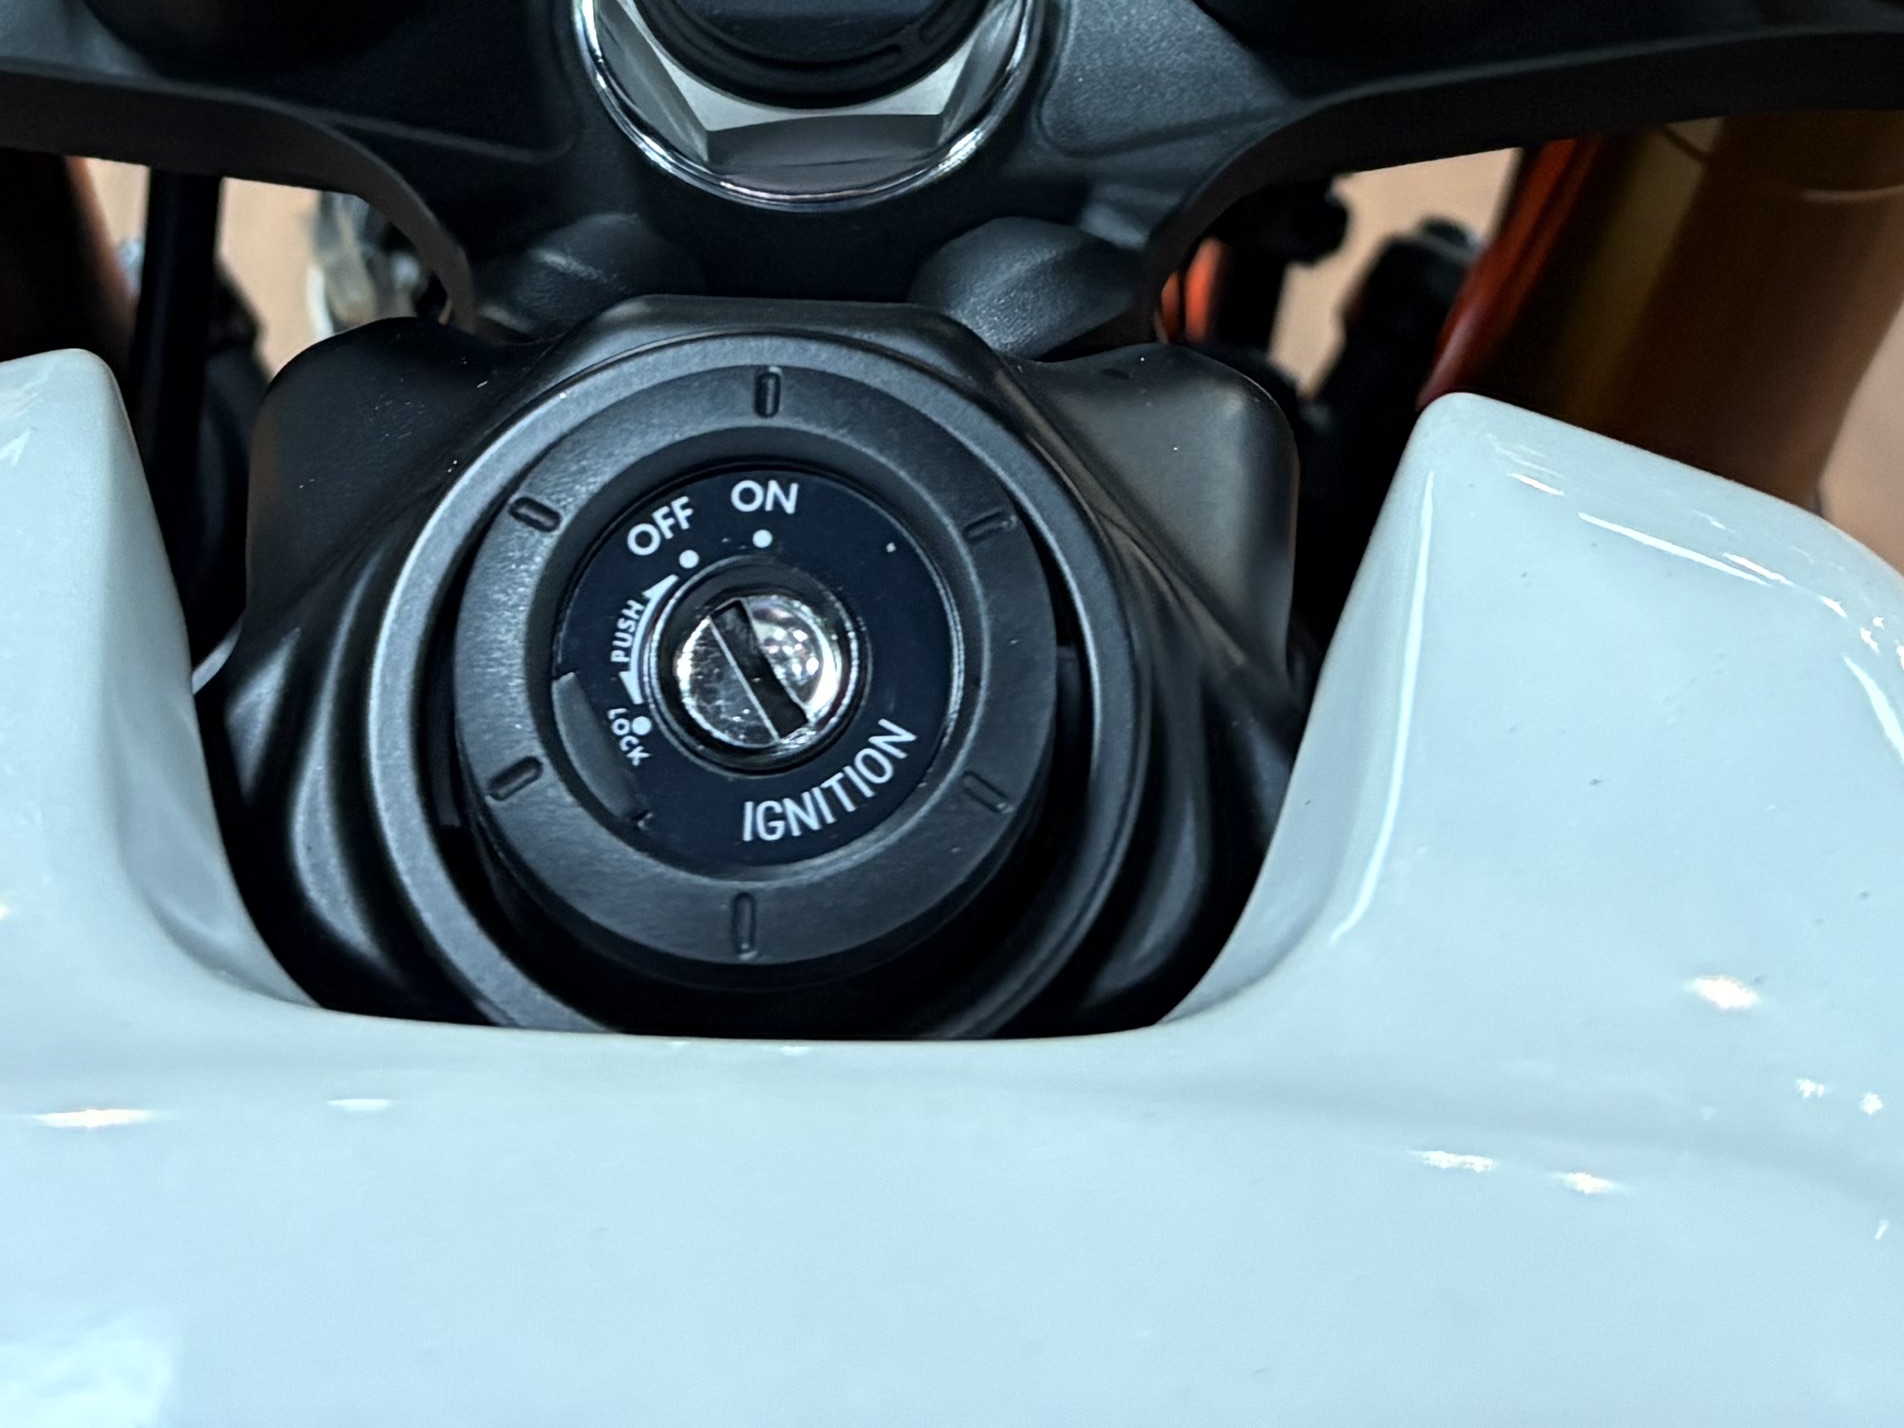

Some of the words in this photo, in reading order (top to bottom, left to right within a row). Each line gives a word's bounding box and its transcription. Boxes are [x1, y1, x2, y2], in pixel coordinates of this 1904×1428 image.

[626, 495, 694, 556] OFF
[730, 479, 799, 515] ON
[610, 599, 647, 663] PUSH
[607, 707, 652, 767] LOCK
[742, 718, 918, 842] IGNITION
